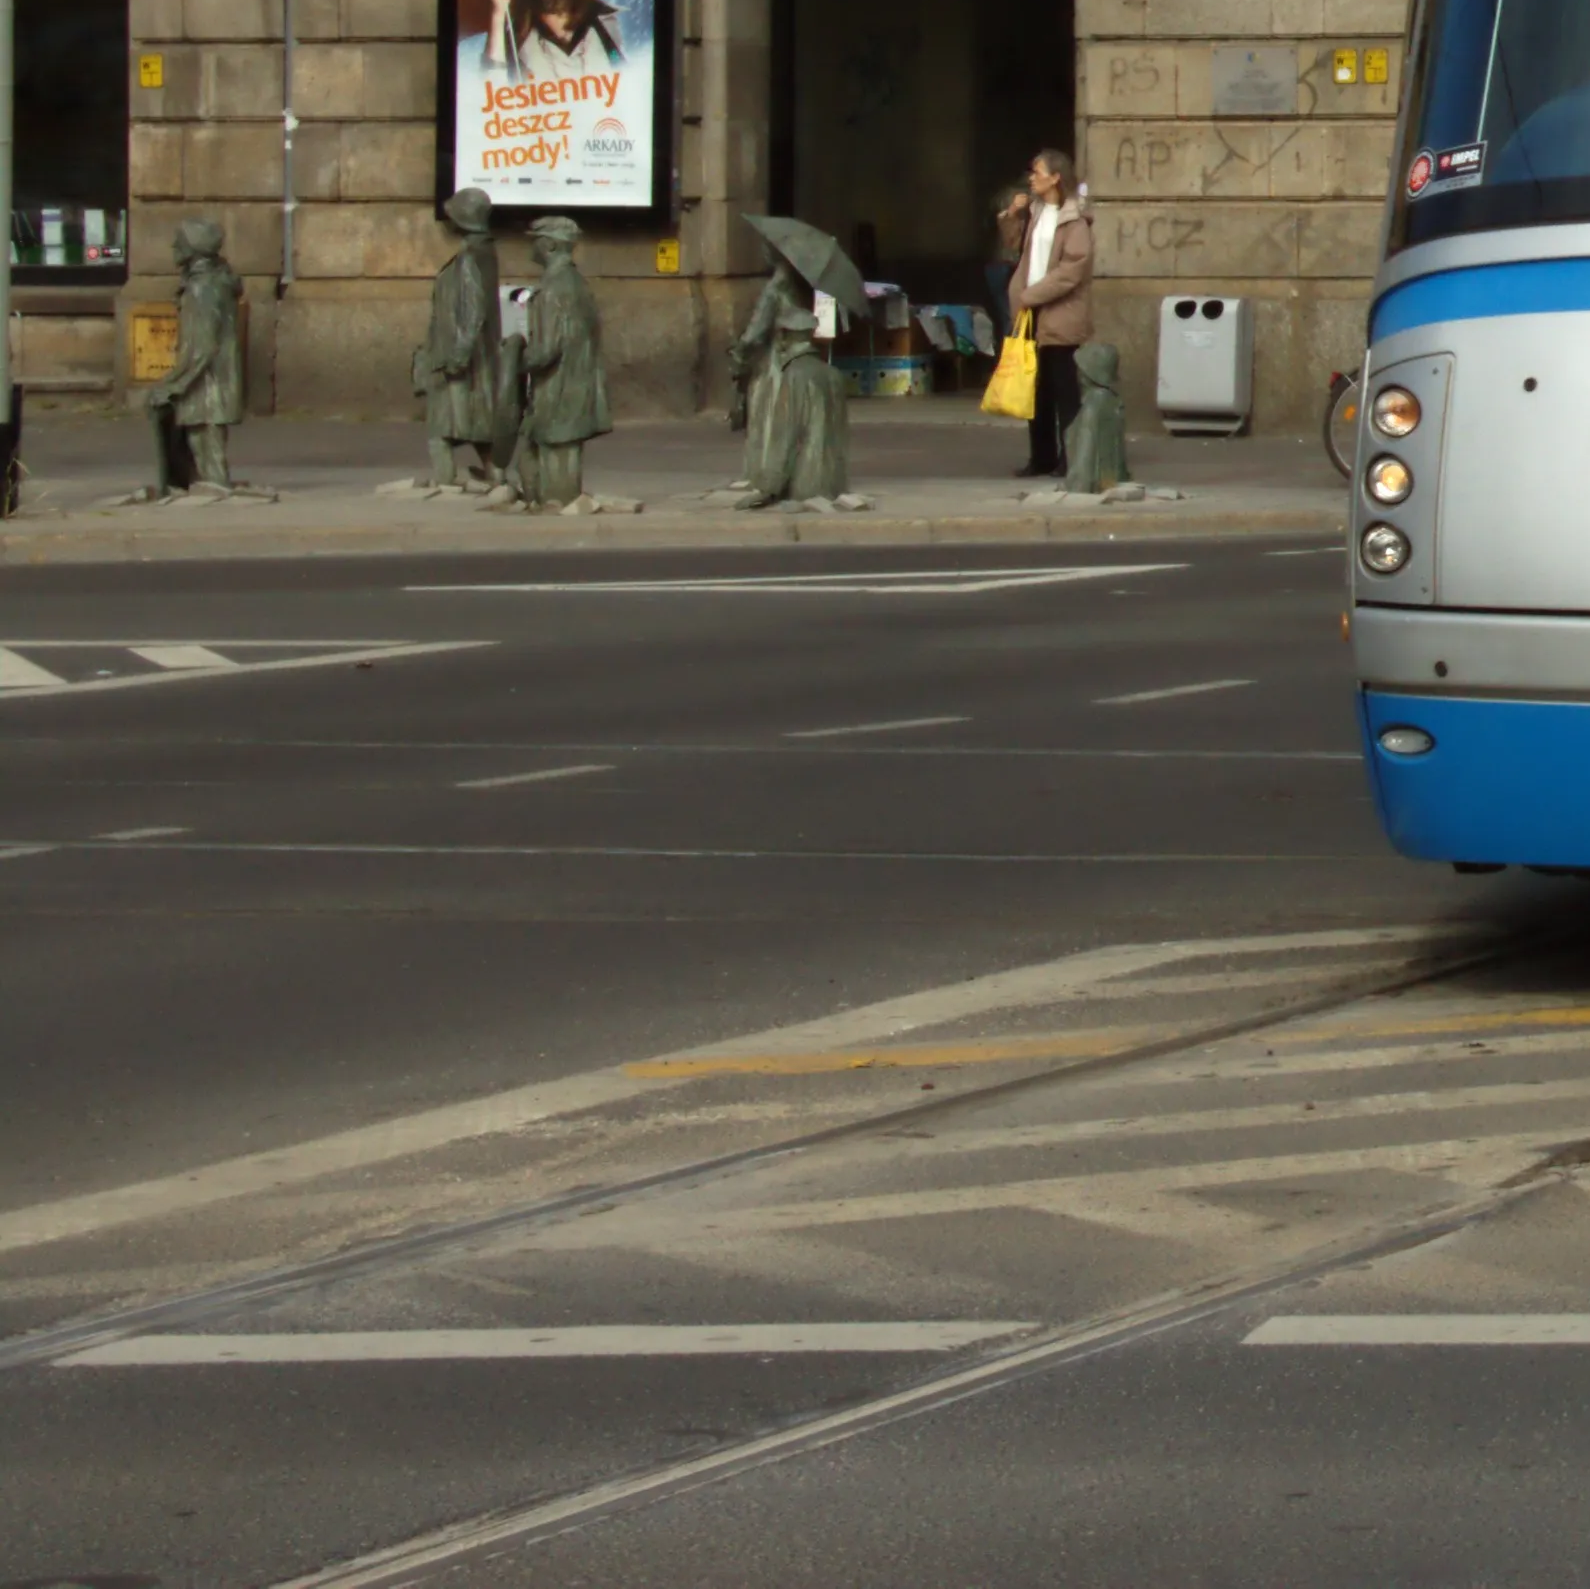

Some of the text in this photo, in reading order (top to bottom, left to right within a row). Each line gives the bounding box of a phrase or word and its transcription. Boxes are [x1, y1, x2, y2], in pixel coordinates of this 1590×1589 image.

[481, 71, 621, 113] Jesienny
[484, 111, 573, 141] deszcz
[482, 138, 571, 171] mody!
[583, 138, 635, 152] ARKADY
